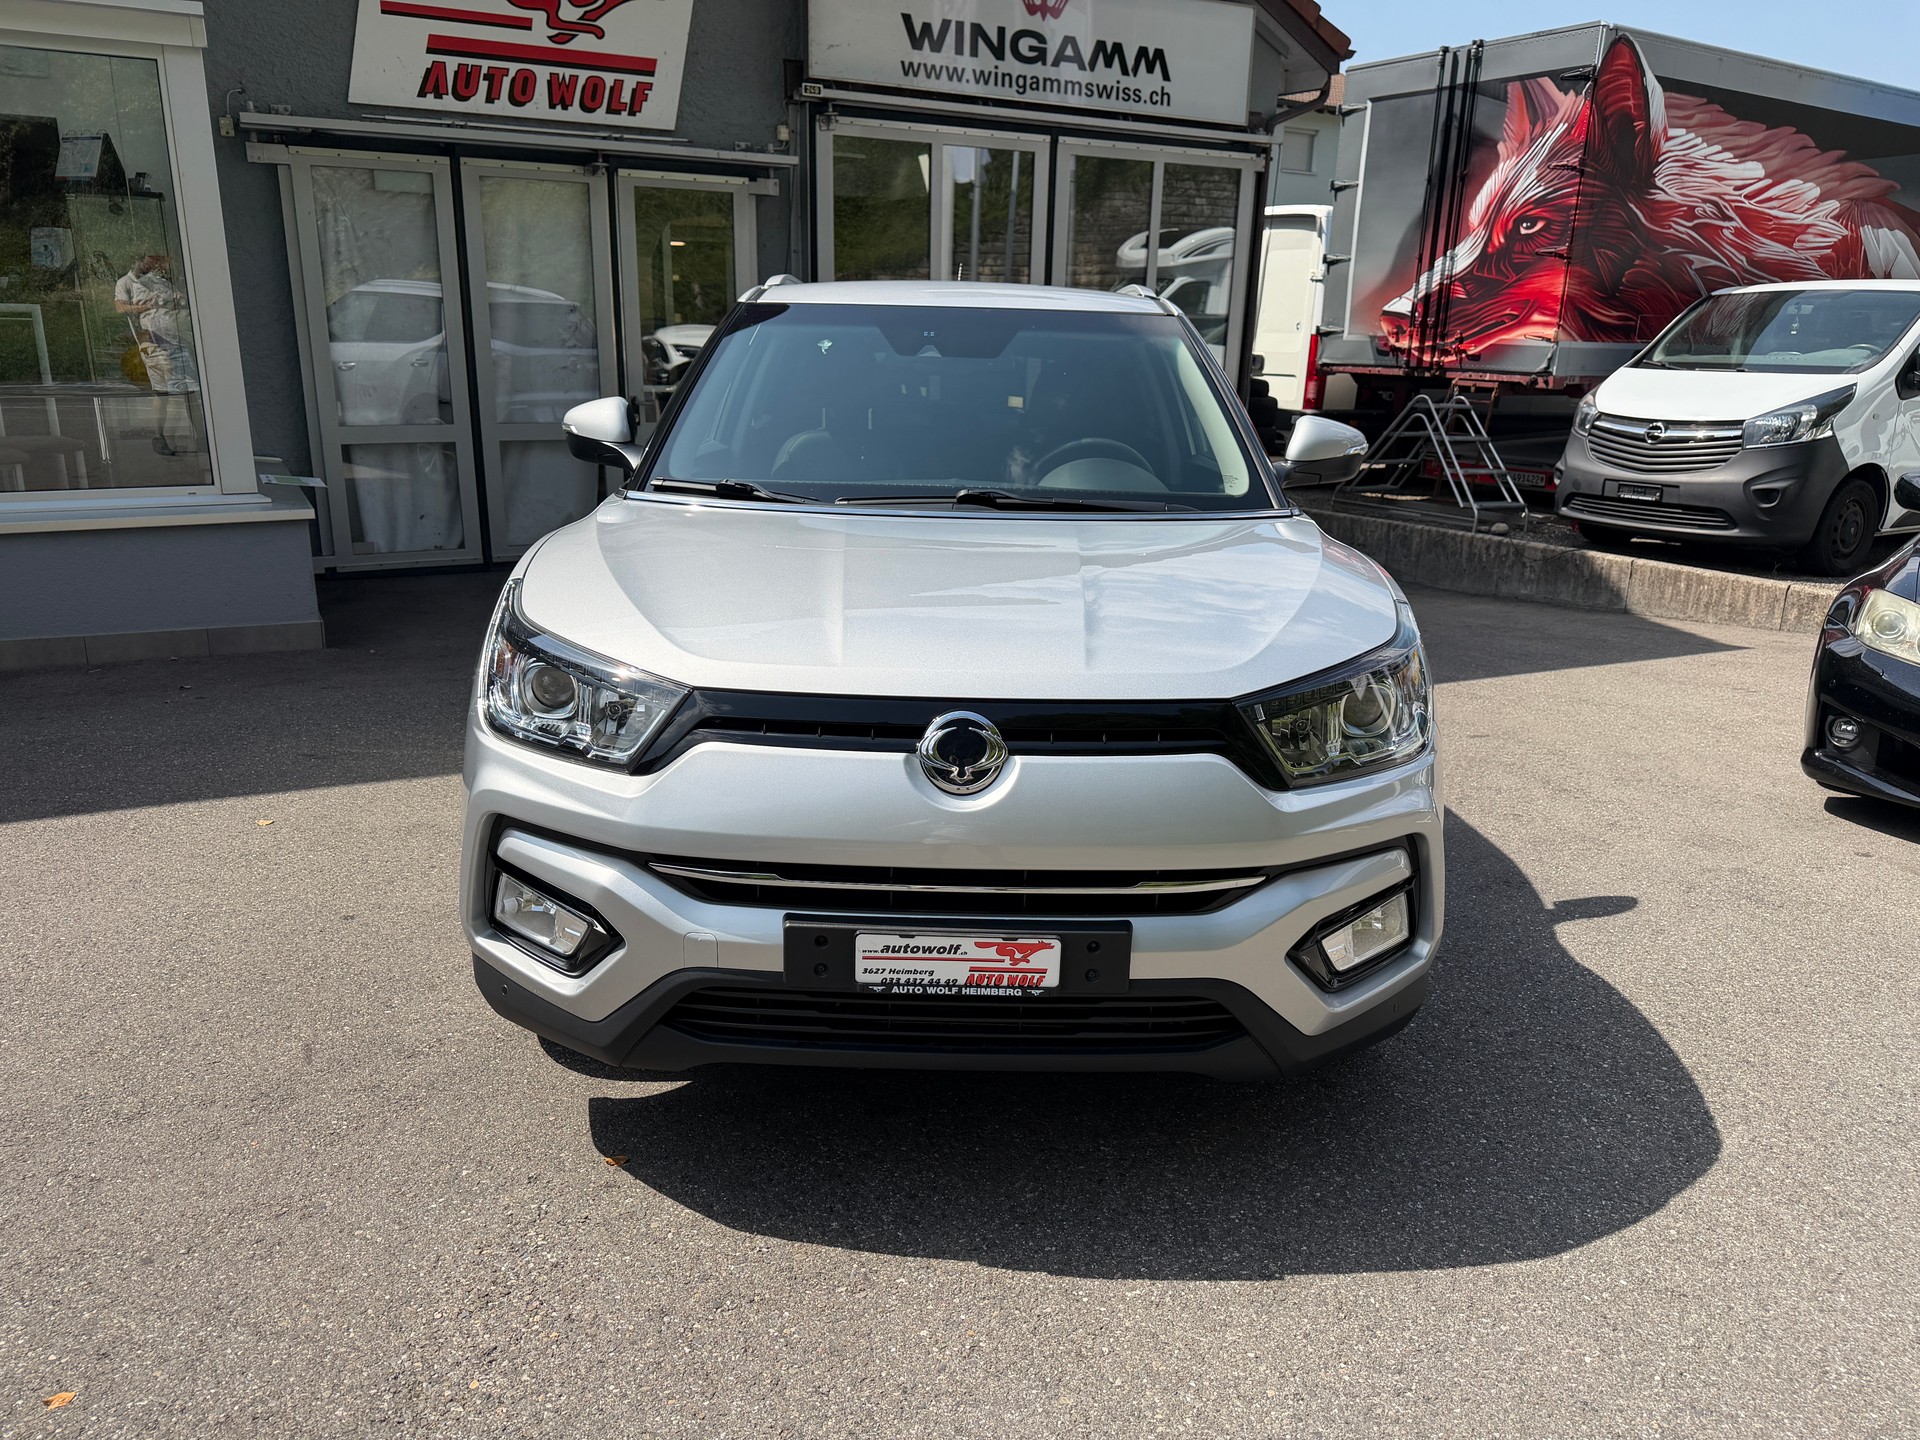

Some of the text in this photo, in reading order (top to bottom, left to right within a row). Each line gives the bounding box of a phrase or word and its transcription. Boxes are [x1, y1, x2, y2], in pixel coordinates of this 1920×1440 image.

[900, 12, 1171, 82] WINGAMM
[417, 60, 653, 117] AUTO WOLF
[900, 60, 1171, 107] www.wingammswiss.ch
[888, 968, 935, 976] Heimberg
[964, 973, 1046, 987] AUTO WOLF
[891, 985, 1022, 996] AUTO WOLF HEIMBERG
